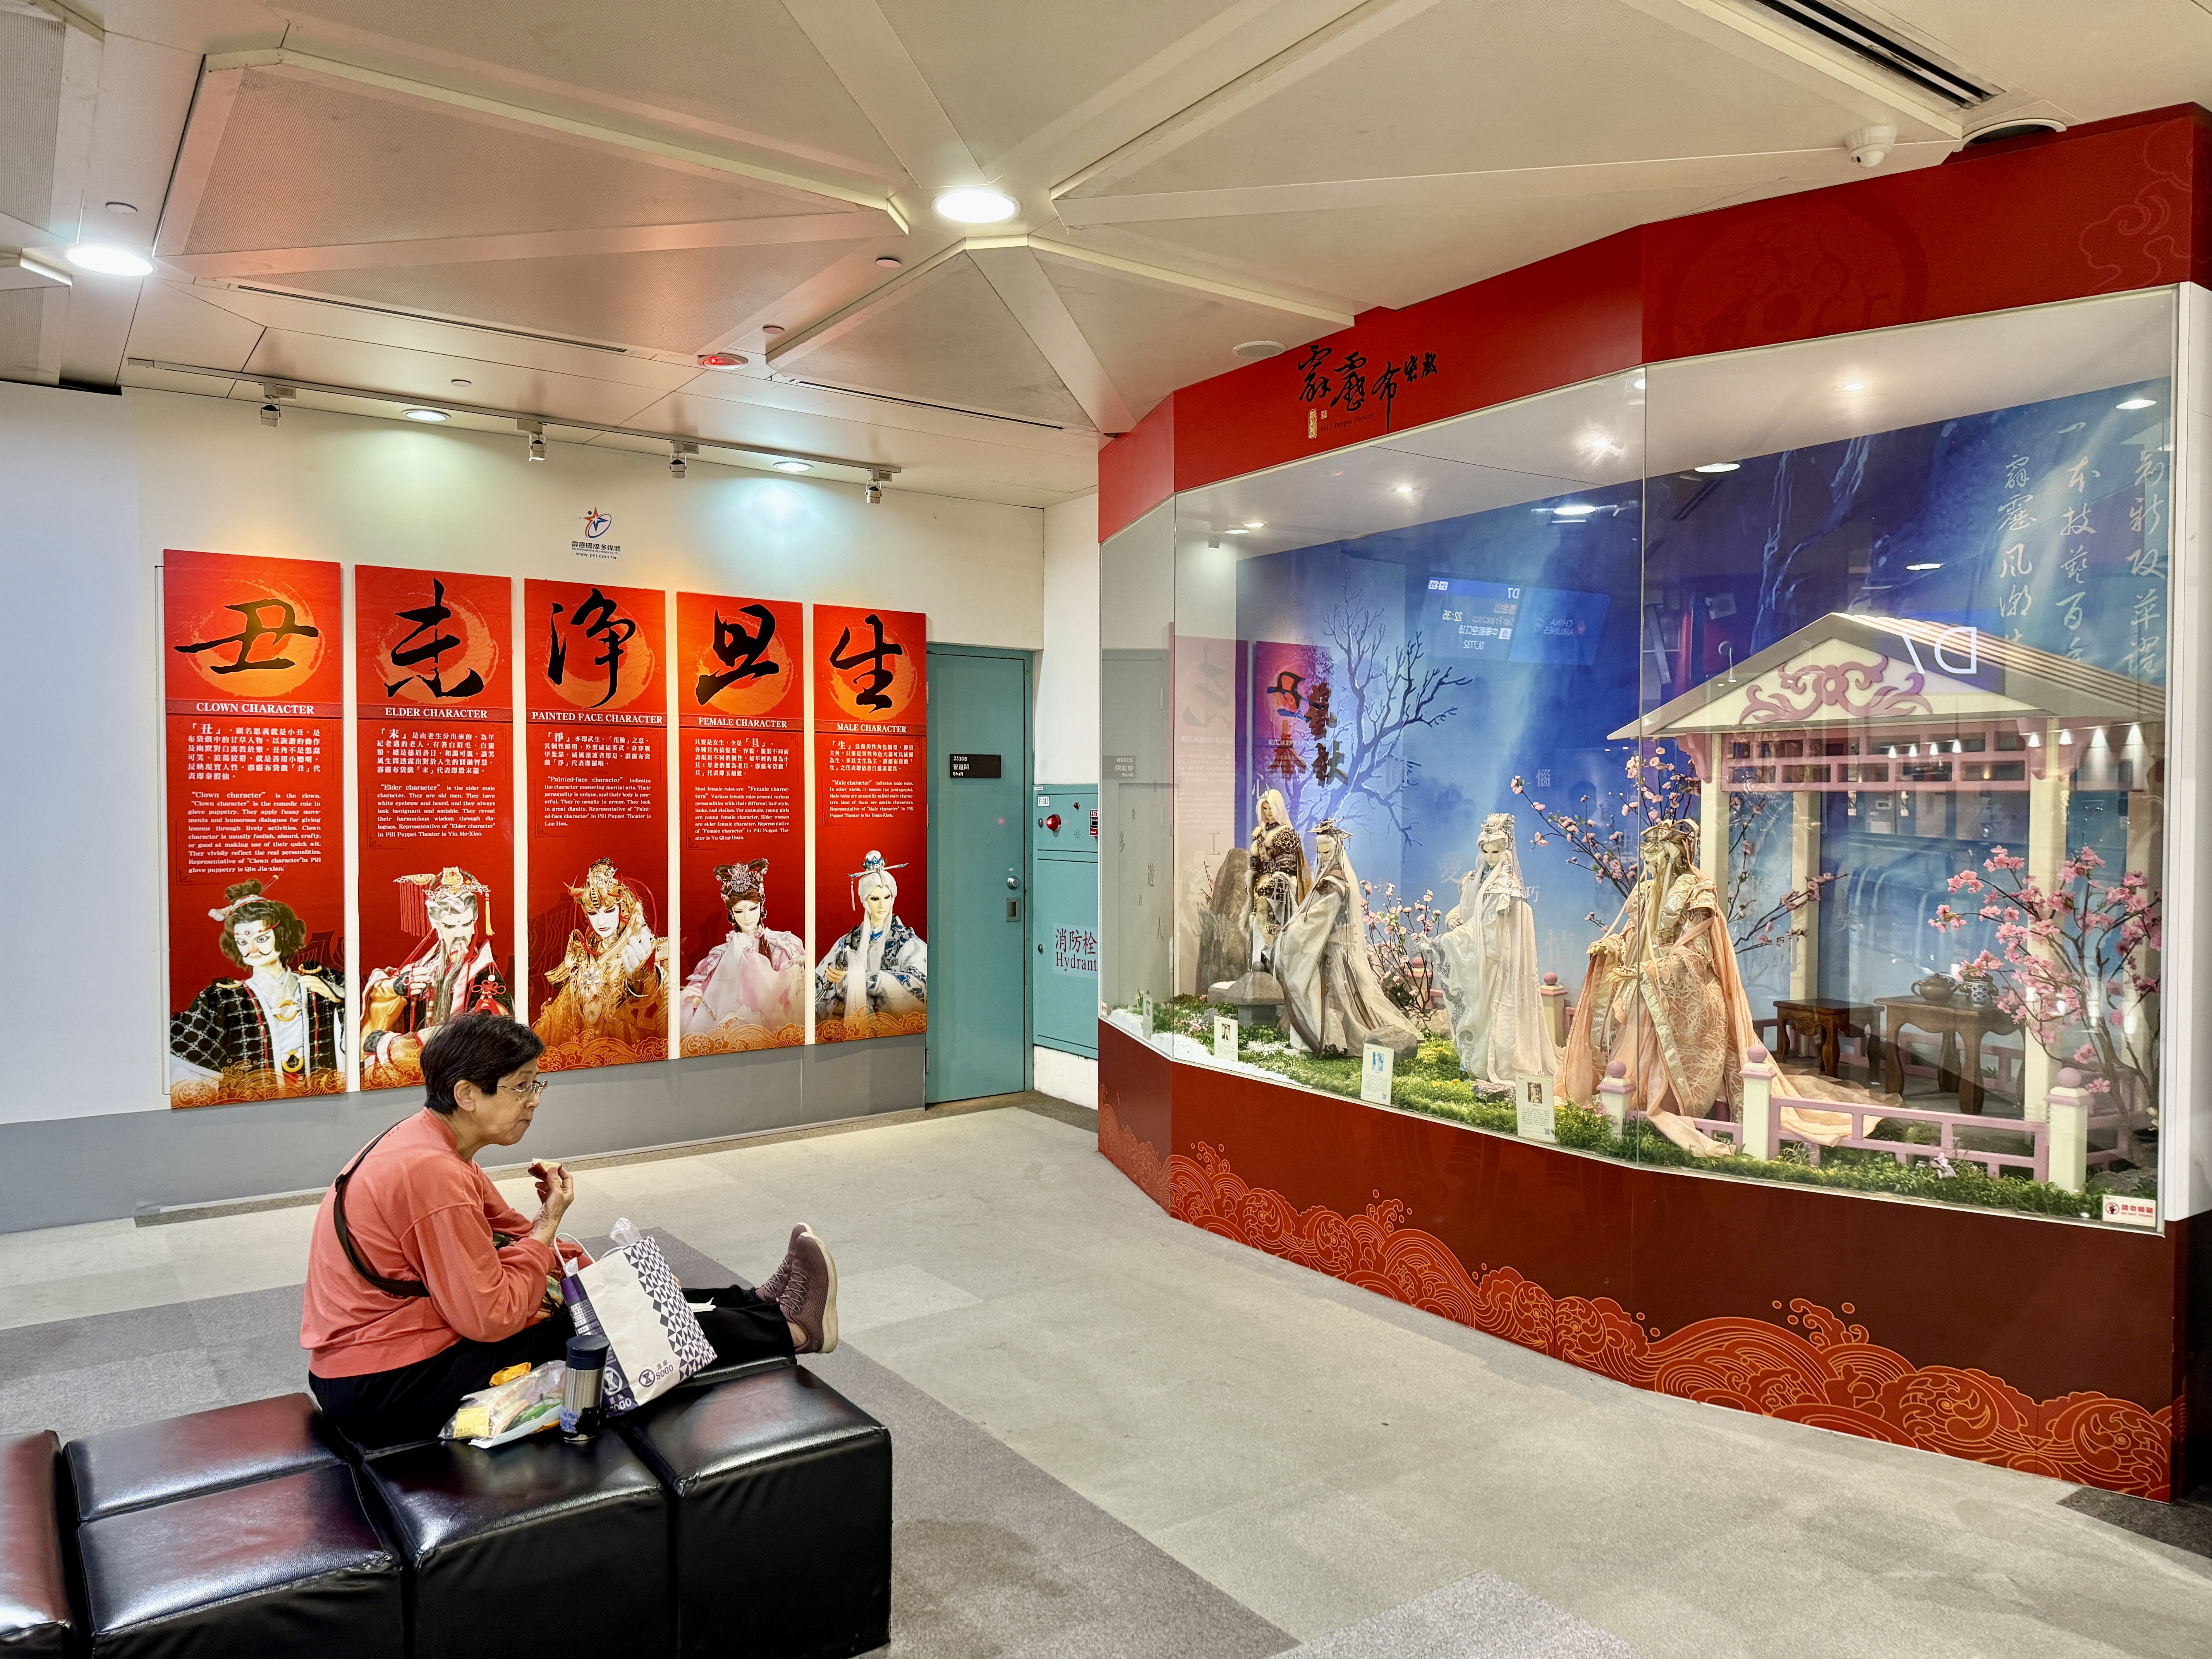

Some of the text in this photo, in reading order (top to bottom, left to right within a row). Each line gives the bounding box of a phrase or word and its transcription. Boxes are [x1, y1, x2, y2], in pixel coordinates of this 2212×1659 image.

[173, 599, 318, 674] 丑
[830, 614, 903, 713] 生
[196, 702, 314, 714] CLOWN CHARACTER
[385, 708, 488, 718] ELDER CHARACTER
[532, 711, 663, 724] PAINTED FACE CHARACTER
[699, 717, 787, 728] FEMALE CHARACTER
[860, 724, 907, 733] CHARACTER
[1055, 928, 1097, 955] 消防栓
[1056, 952, 1097, 972] Hydrant
[656, 1364, 673, 1380] SOGO
